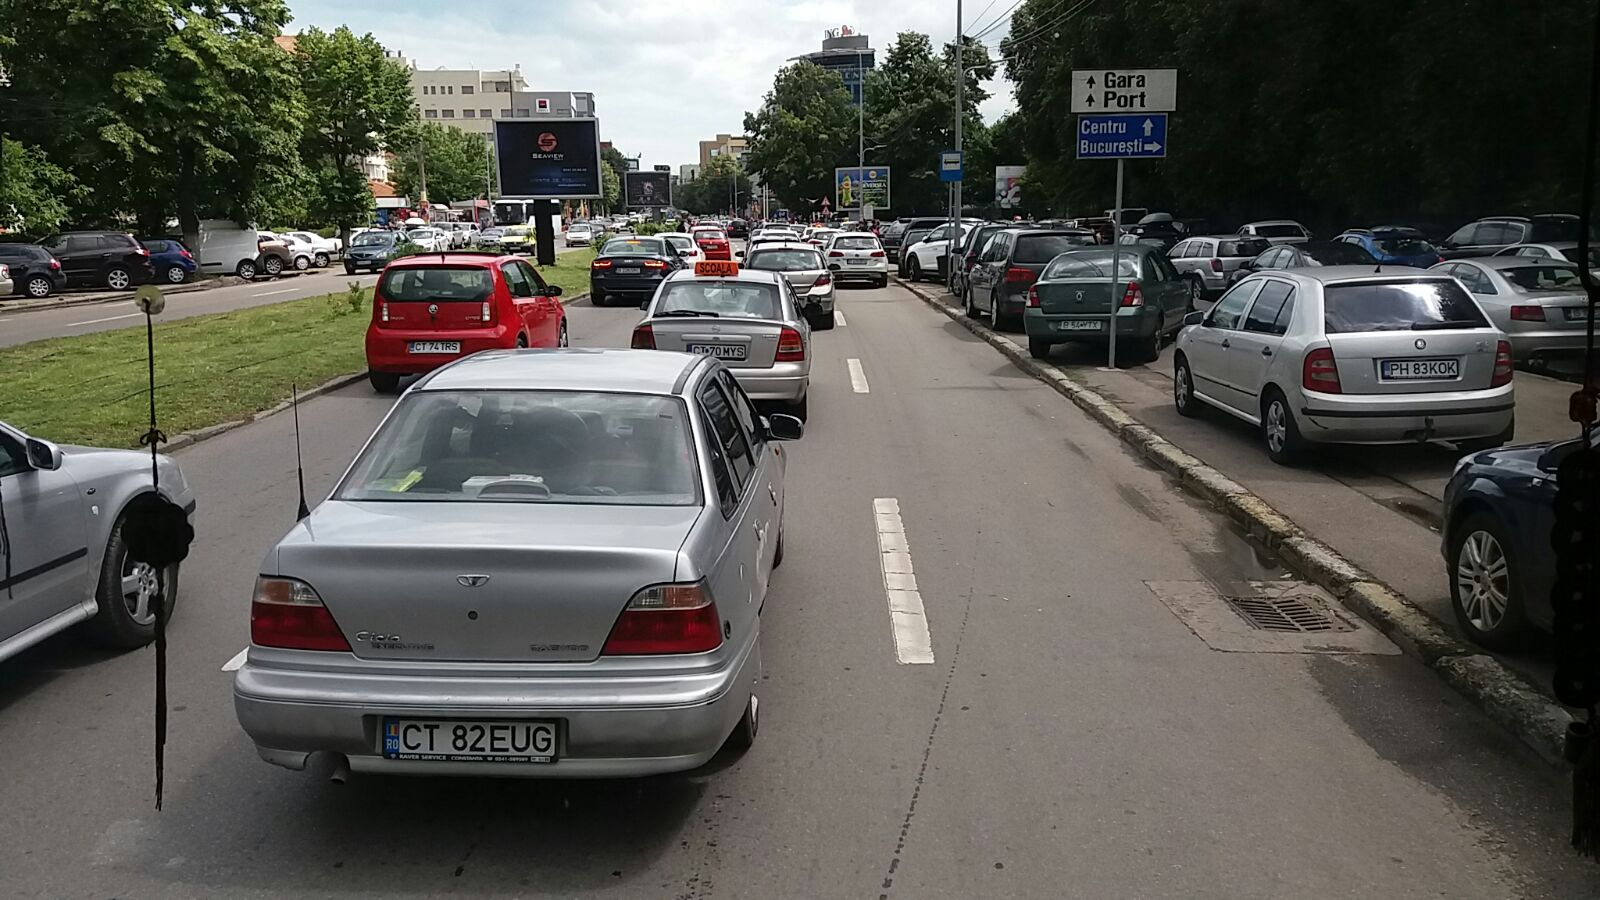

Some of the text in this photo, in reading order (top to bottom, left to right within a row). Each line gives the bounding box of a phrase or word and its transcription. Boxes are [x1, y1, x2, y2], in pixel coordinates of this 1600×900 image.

[824, 27, 840, 39] ING
[1104, 72, 1146, 88] Gara
[1103, 90, 1146, 108] Port
[1081, 119, 1127, 134] Centru
[1080, 139, 1143, 156] București
[415, 342, 427, 351] CT
[1390, 363, 1409, 375] PH
[386, 738, 399, 750] RO
[402, 723, 552, 753] CT 82EUG
